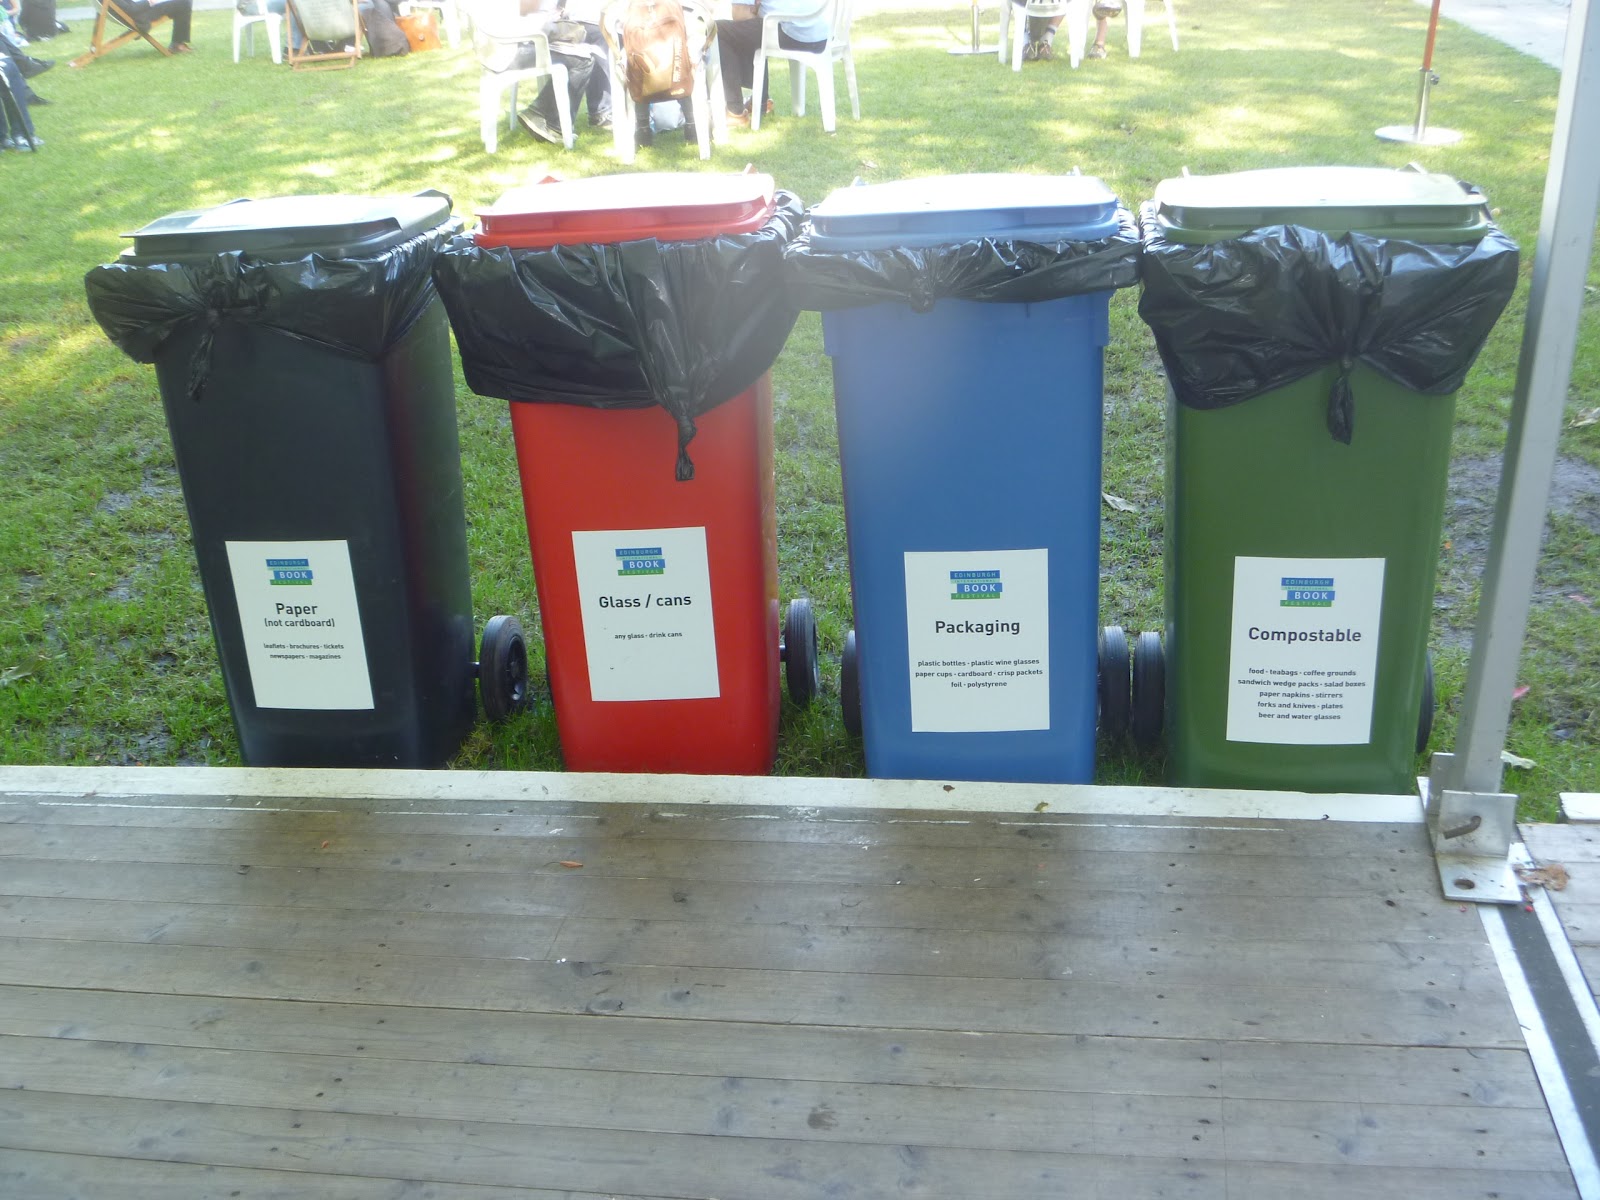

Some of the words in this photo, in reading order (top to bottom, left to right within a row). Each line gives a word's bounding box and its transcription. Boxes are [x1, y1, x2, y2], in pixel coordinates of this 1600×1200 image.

[964, 584, 996, 592] BOOK
[599, 596, 641, 608] Glass
[645, 594, 651, 608] /
[656, 596, 691, 606] cans
[276, 603, 318, 617] Paper
[264, 618, 282, 627] (not
[285, 618, 335, 627] cardboard)
[936, 620, 1020, 636] Packaging
[1248, 627, 1361, 644] Compostable
